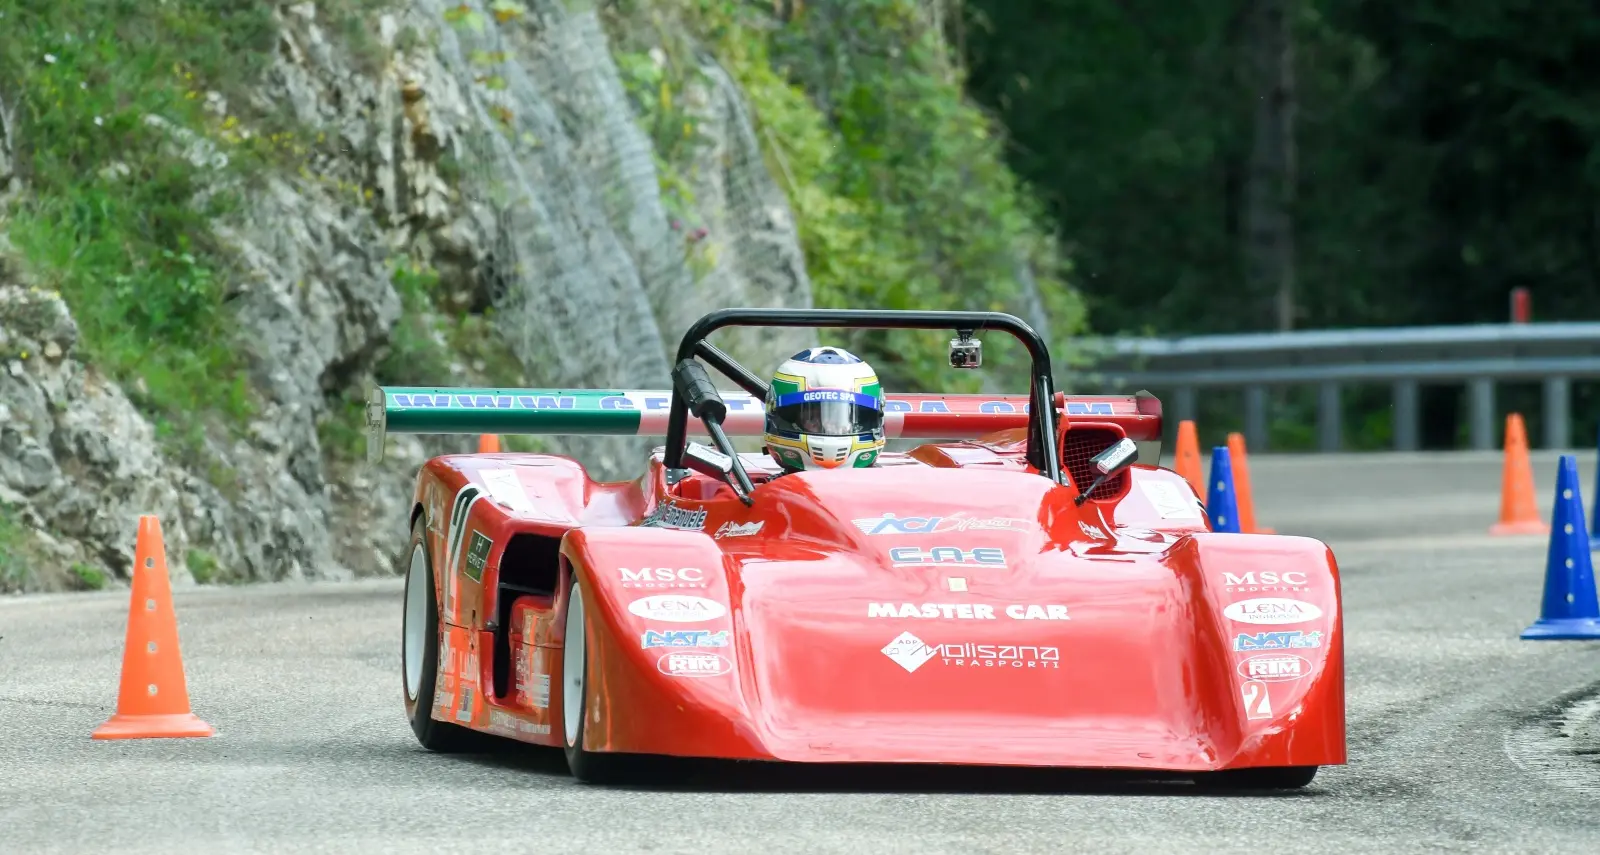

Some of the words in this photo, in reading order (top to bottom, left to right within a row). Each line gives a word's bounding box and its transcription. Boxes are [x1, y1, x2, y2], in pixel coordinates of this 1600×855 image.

[803, 391, 838, 402] GEOTEC
[839, 391, 856, 402] SPA
[618, 567, 705, 582] MSC
[1222, 571, 1309, 585] MSC
[644, 600, 710, 611] LENA
[1240, 603, 1304, 614] LENA
[867, 602, 997, 620] MASTER
[1005, 604, 1071, 621] CAR
[942, 658, 1059, 669] TRASPORTI
